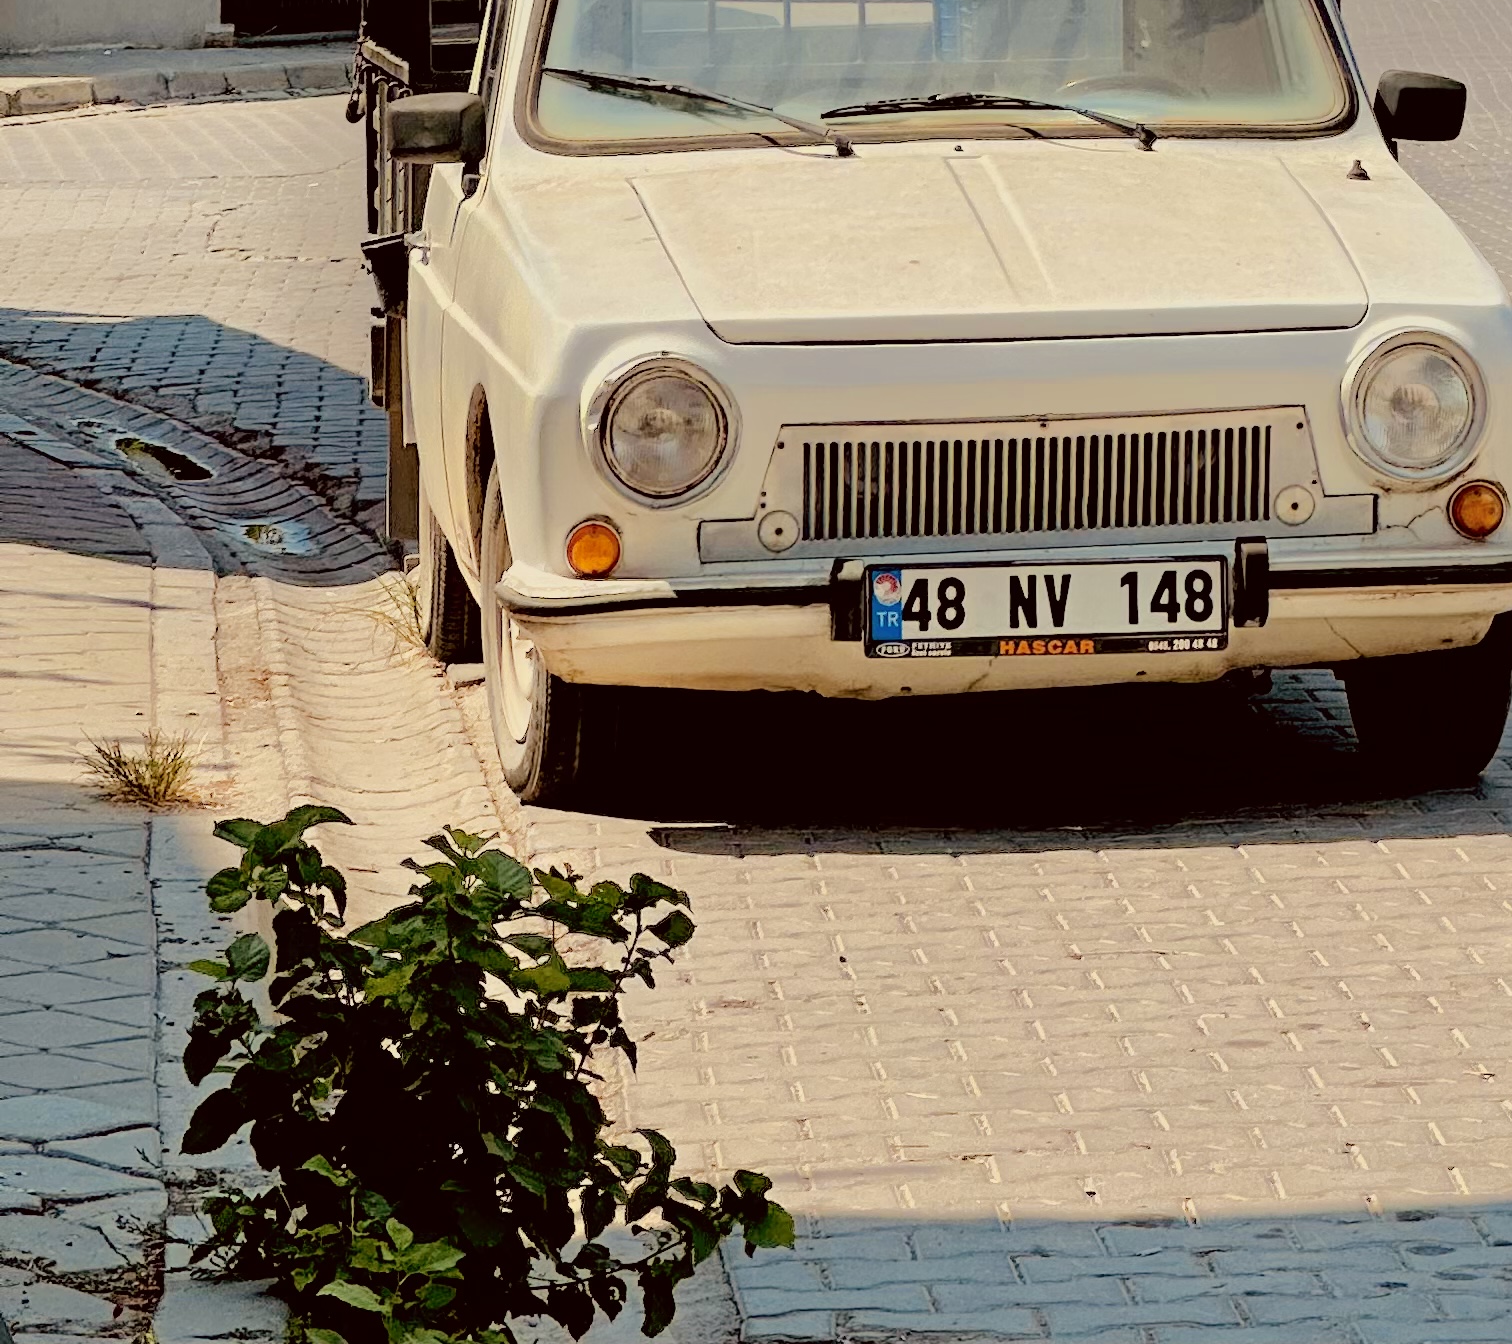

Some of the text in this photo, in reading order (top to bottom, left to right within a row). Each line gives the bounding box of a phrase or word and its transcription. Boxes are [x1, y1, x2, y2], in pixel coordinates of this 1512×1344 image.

[902, 569, 1215, 632] 48 NV 148
[876, 611, 899, 628] TR
[999, 639, 1095, 655] HASCAR
